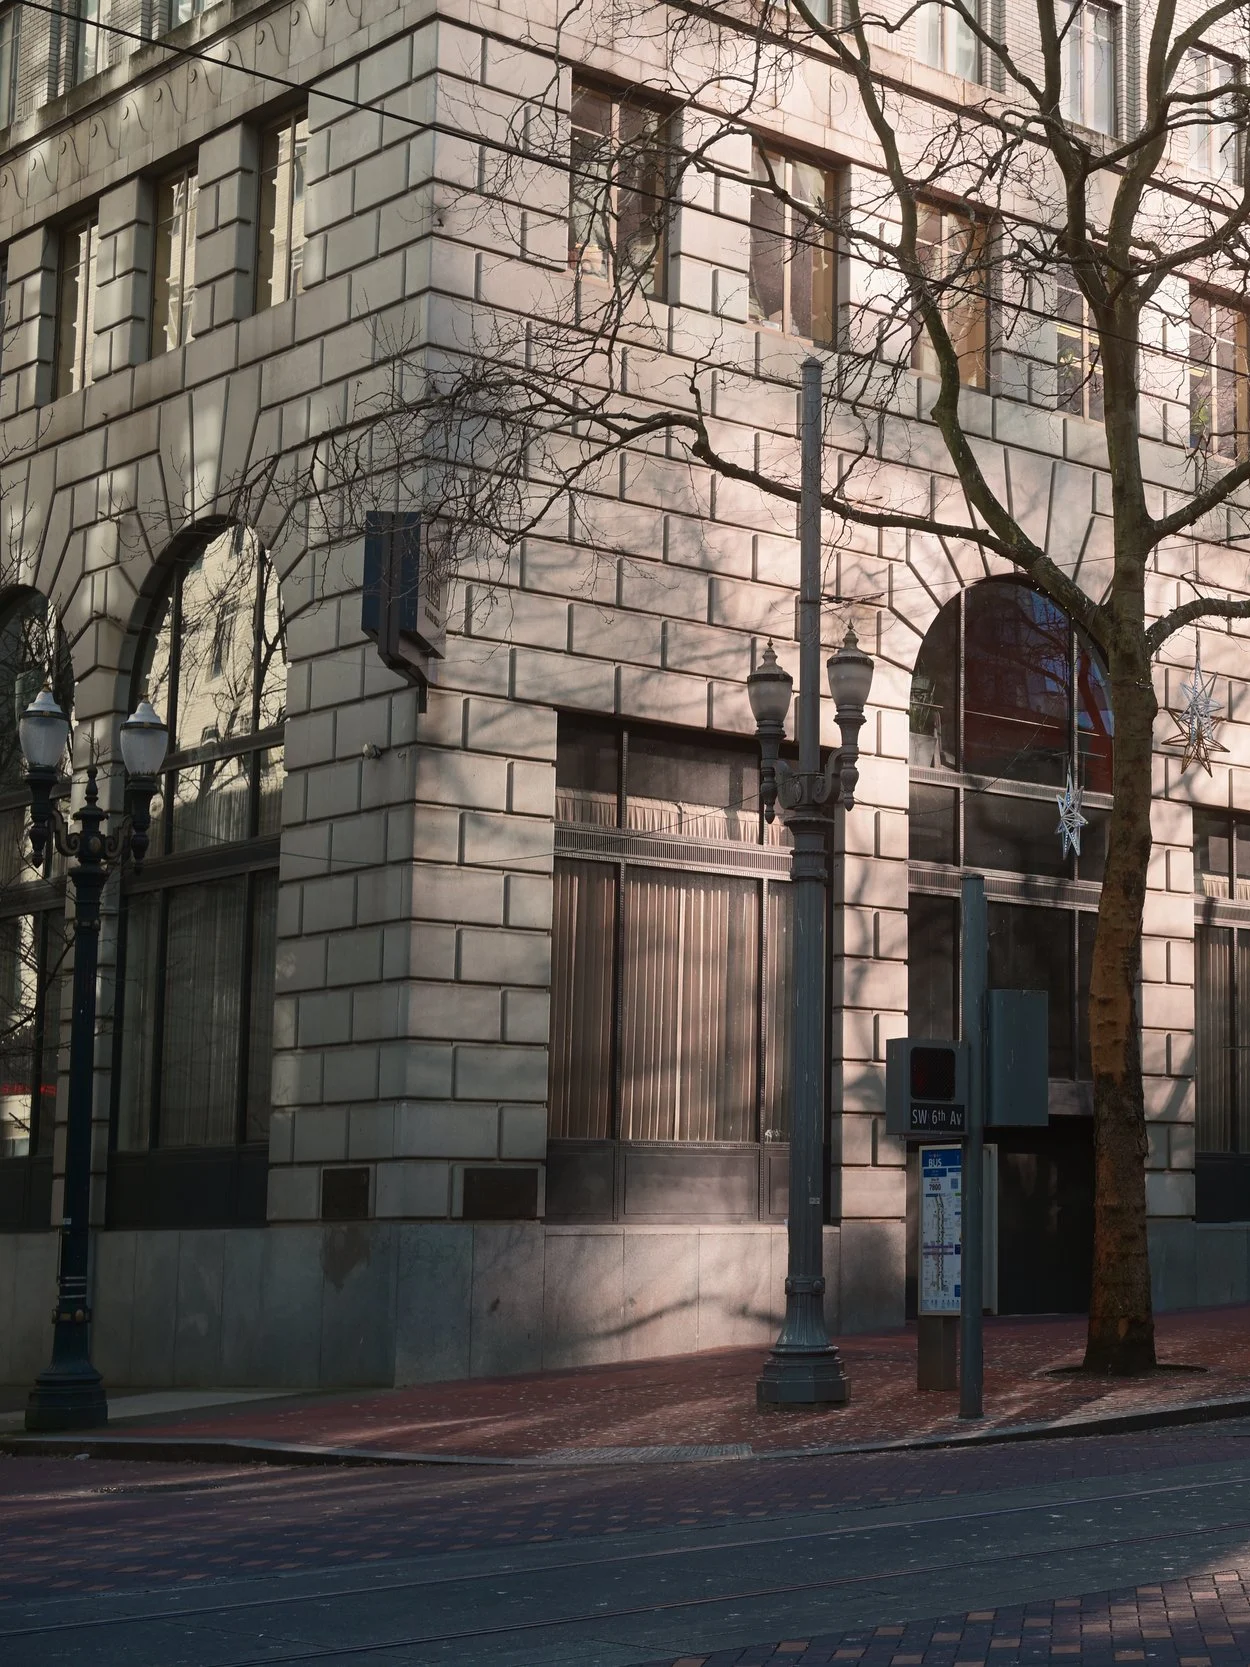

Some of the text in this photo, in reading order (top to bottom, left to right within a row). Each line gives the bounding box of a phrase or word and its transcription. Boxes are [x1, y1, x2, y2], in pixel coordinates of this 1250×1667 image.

[912, 1109, 928, 1125] SW
[931, 1109, 946, 1125] 6th
[928, 1158, 942, 1168] BUS
[928, 1183, 942, 1191] 7800
